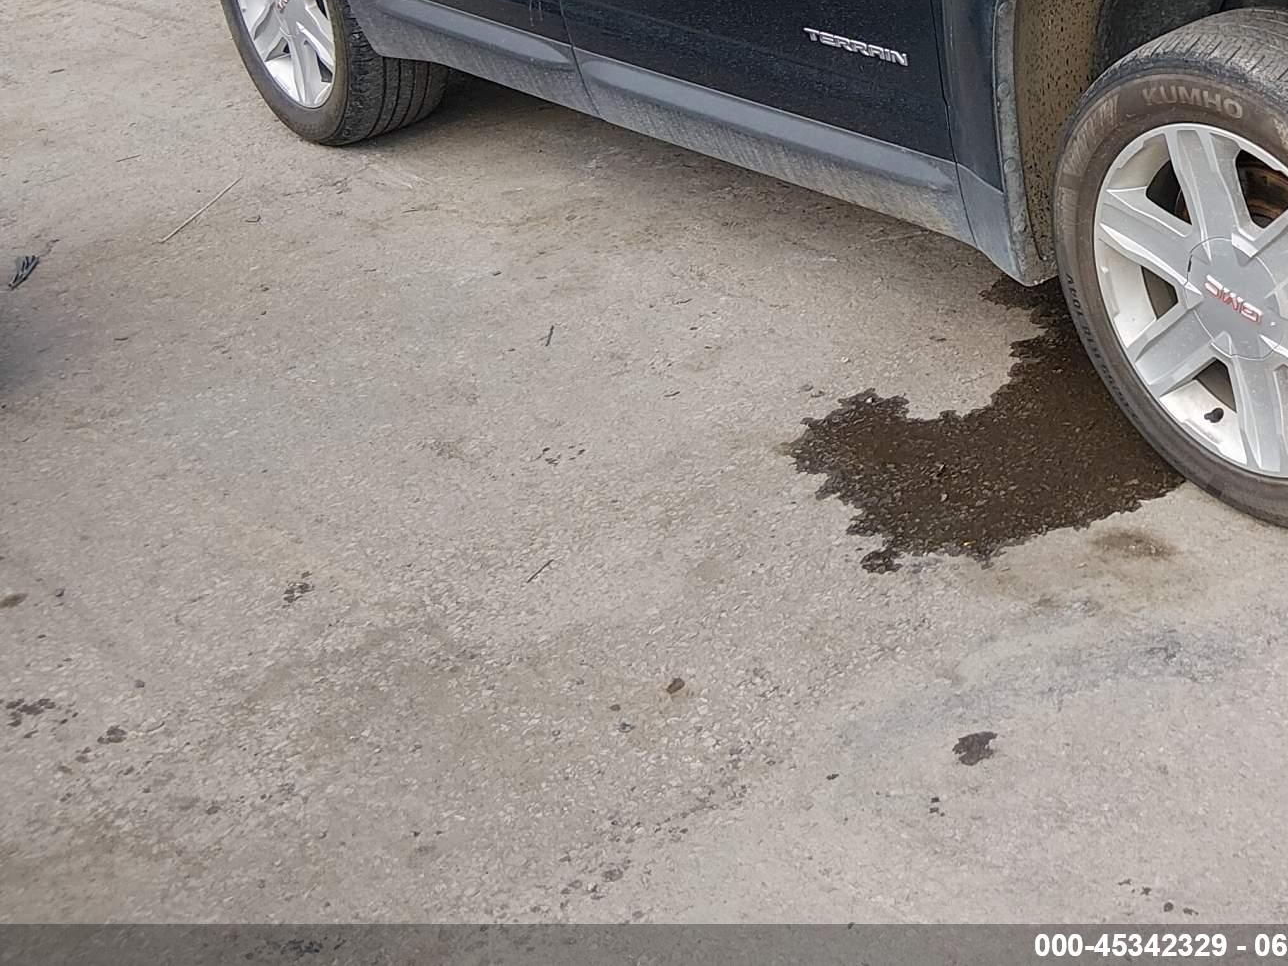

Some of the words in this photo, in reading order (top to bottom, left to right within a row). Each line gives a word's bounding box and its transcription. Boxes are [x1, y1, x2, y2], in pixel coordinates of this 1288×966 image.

[803, 27, 909, 67] TERRAIN
[1142, 85, 1244, 119] KUMHO
[1204, 274, 1262, 323] GMC
